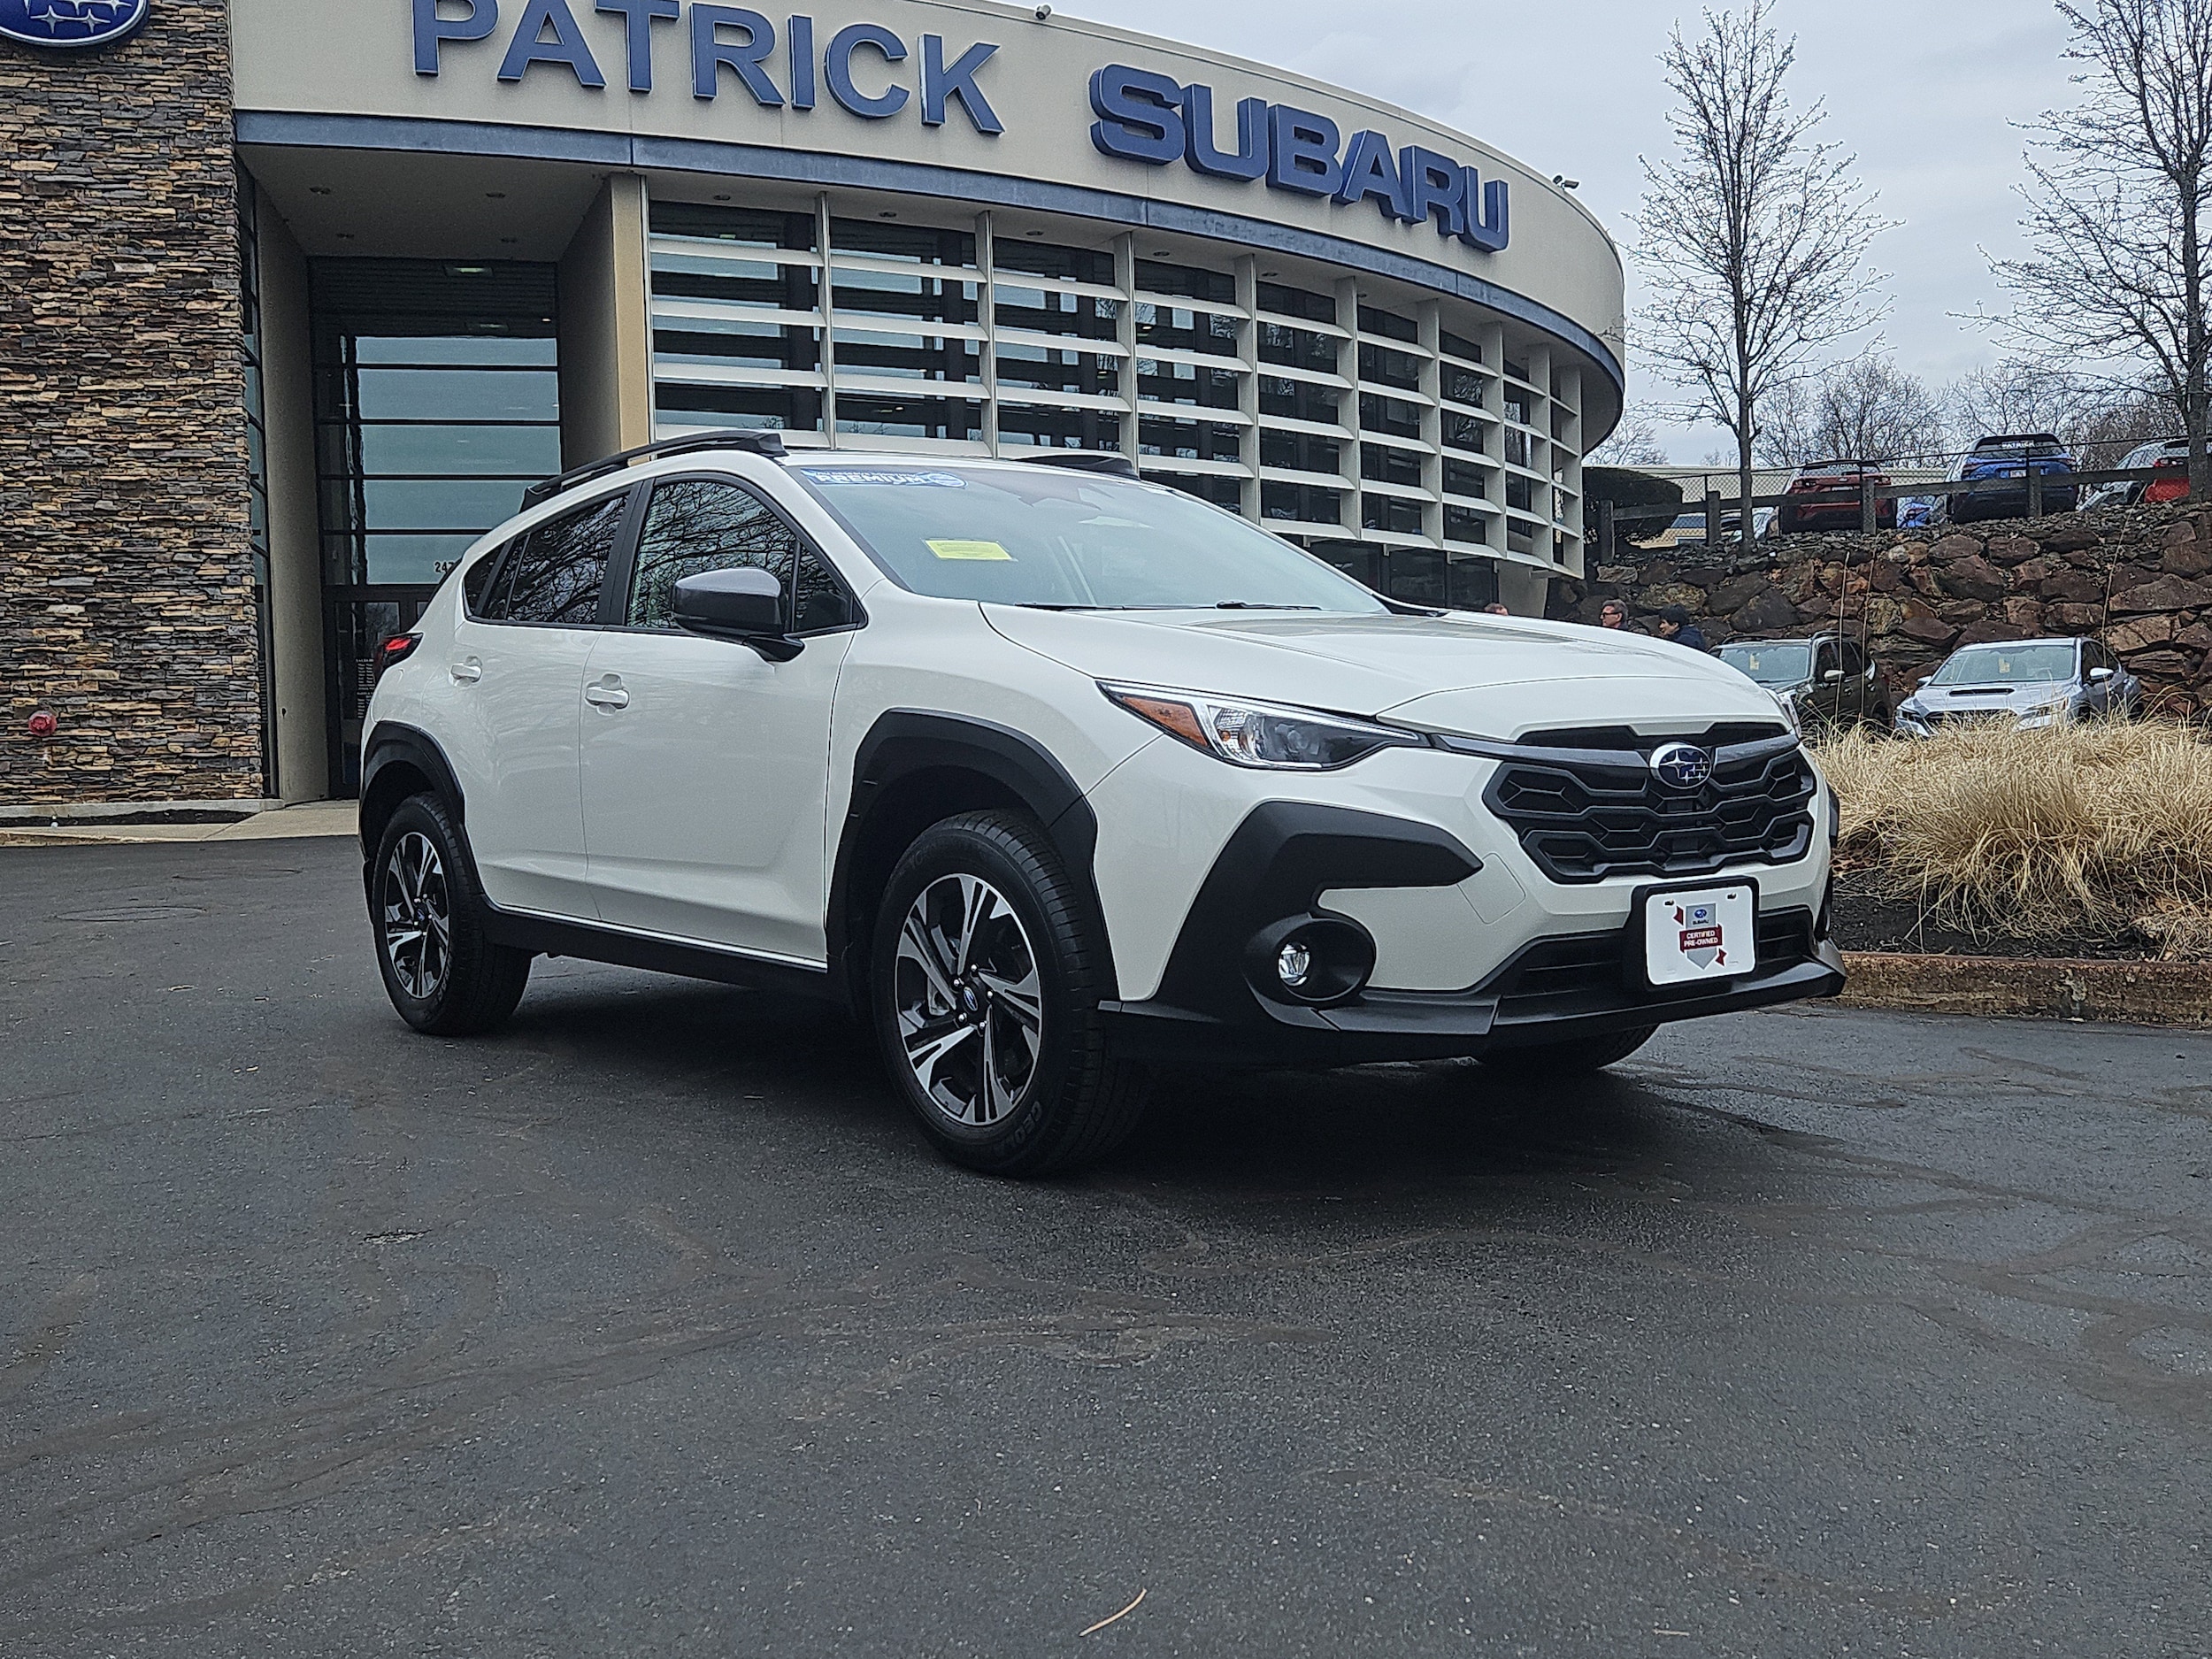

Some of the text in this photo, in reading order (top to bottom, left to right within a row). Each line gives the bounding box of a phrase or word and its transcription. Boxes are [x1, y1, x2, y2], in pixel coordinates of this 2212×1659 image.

[411, 0, 1509, 253] PATRICK SUBARU
[816, 475, 927, 484] PREMIUM
[1686, 930, 1716, 940] CERTIFIED
[1684, 937, 1718, 947] PRE-OWNED
